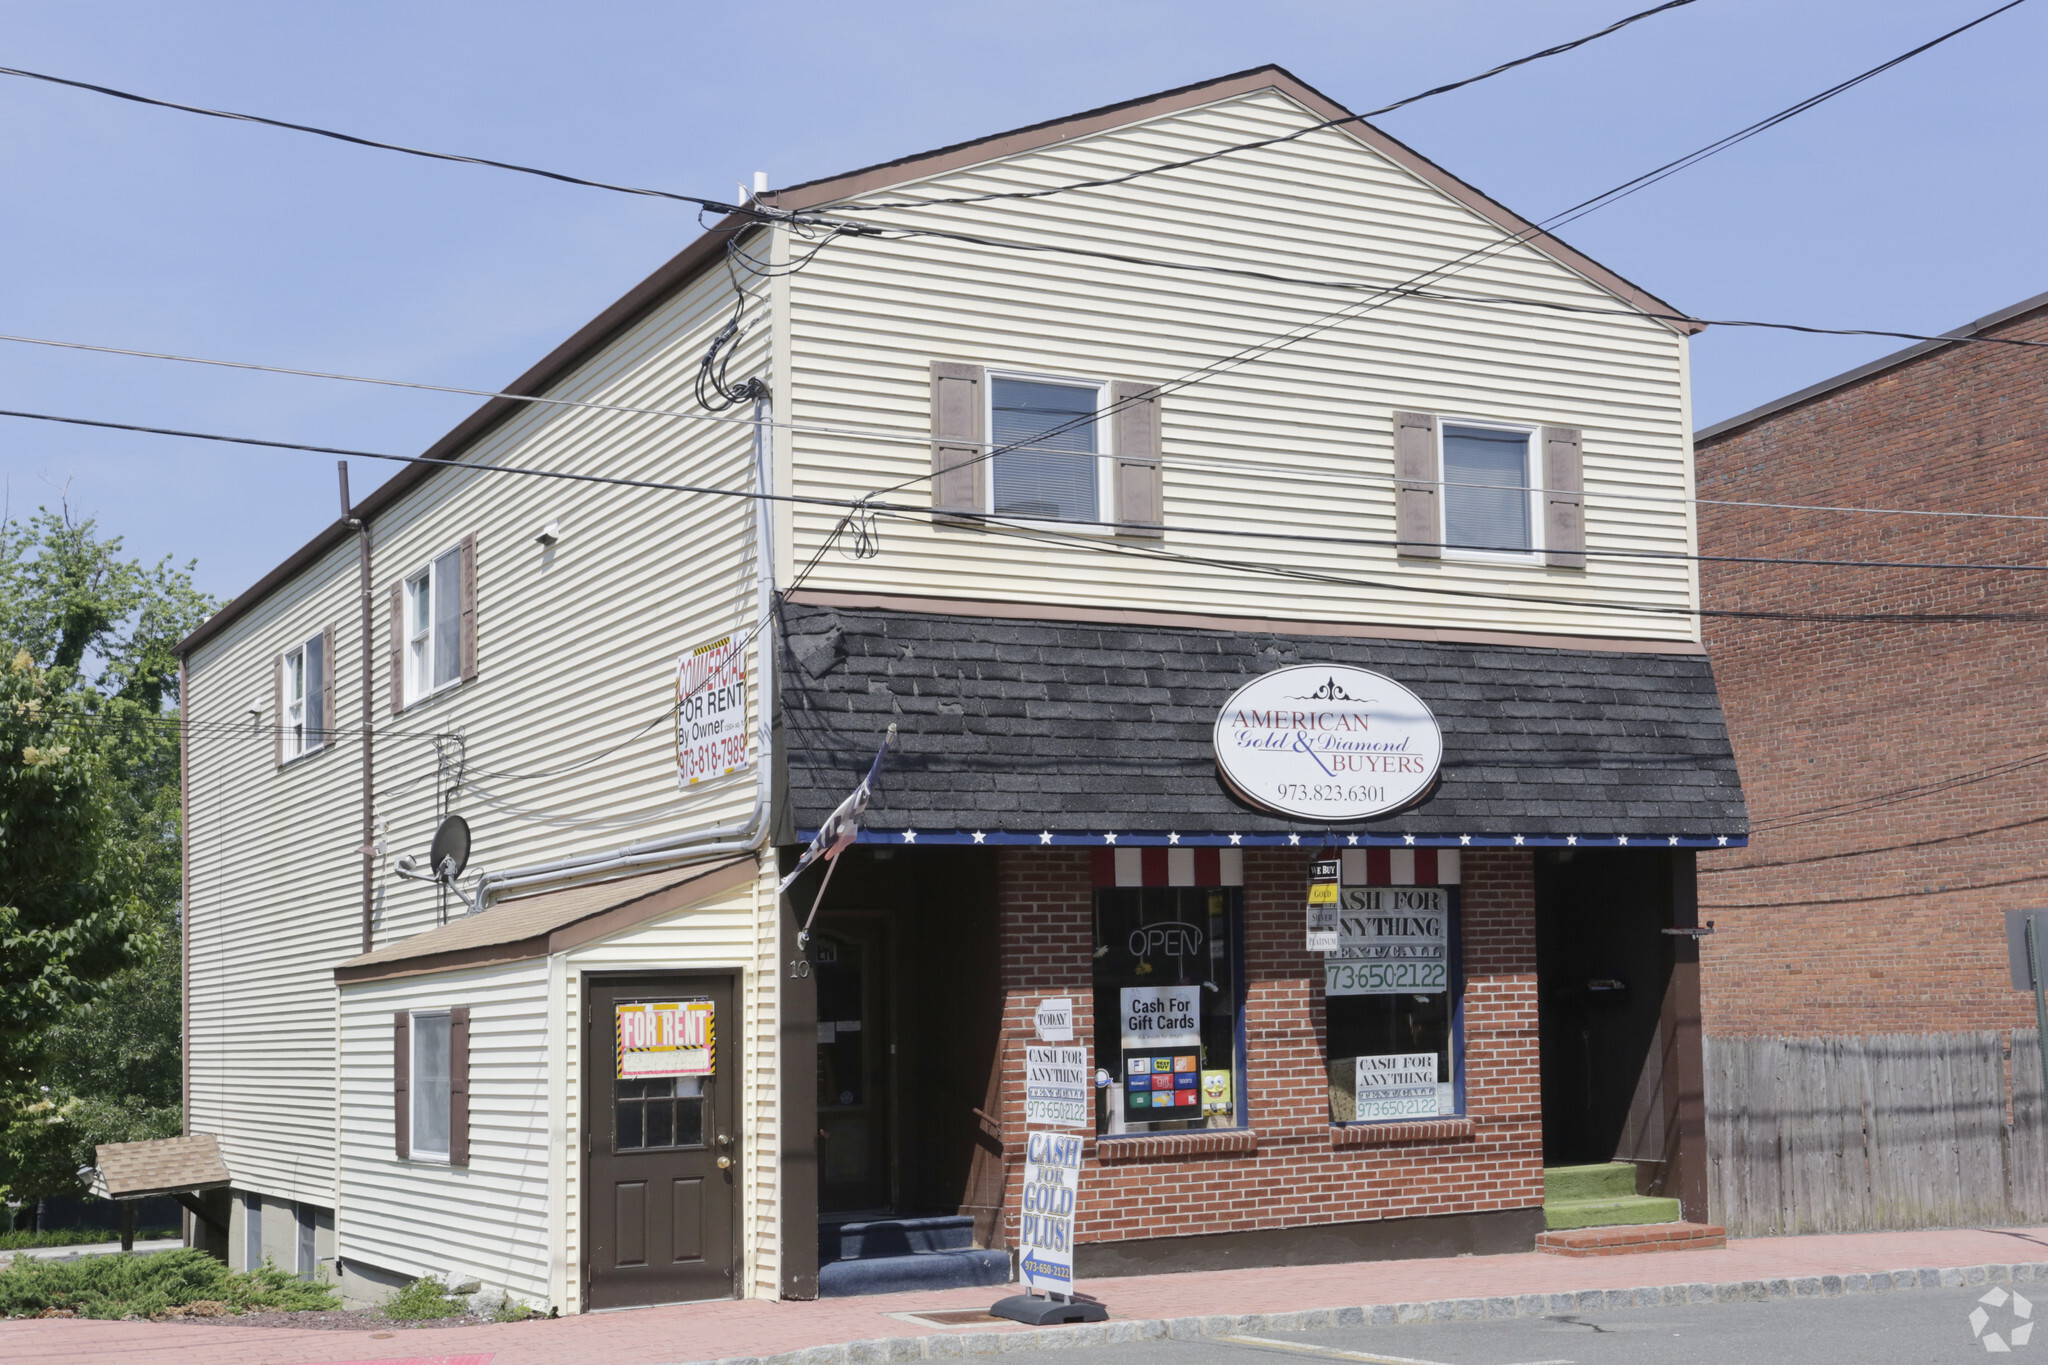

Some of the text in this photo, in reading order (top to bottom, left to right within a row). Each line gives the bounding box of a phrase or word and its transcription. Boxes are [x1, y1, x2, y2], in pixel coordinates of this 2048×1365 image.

[678, 639, 745, 702] COMMERCIAL
[678, 681, 744, 726] FOR RENT
[1231, 709, 1370, 732] AMERICAN
[678, 727, 690, 748] By
[691, 718, 725, 741] Owner
[678, 733, 746, 779] 973-818-7989
[1233, 729, 1410, 778] Gold & Diamond
[1332, 754, 1425, 774] BUYERS
[1277, 783, 1386, 802] 973.823.6301
[1310, 865, 1336, 875] WE BUY
[1314, 890, 1332, 898] GOLD
[1393, 890, 1440, 911] FOR
[1311, 913, 1333, 921] SILVER
[1128, 929, 1199, 956] OPEN
[1308, 937, 1337, 946] PLATINUM
[789, 960, 810, 978] 10
[1132, 997, 1191, 1014] Cash For
[623, 1010, 707, 1047] FOR RENT
[1038, 1012, 1067, 1026] TODAY
[1128, 1013, 1195, 1031] Gift Cards
[1029, 1048, 1082, 1065] CASH FOR
[1359, 1056, 1432, 1071] CASH FOR
[1029, 1067, 1083, 1084] ANYTHING
[1360, 1071, 1432, 1087] ANYTHING
[1360, 1087, 1436, 1099] TEXT/CALL
[1028, 1133, 1081, 1169] CASH
[1035, 1165, 1064, 1187] FOR
[1023, 1181, 1074, 1217] GOLD
[1021, 1212, 1072, 1254] PLUS!
[1024, 1260, 1070, 1279] 973-650-2122
